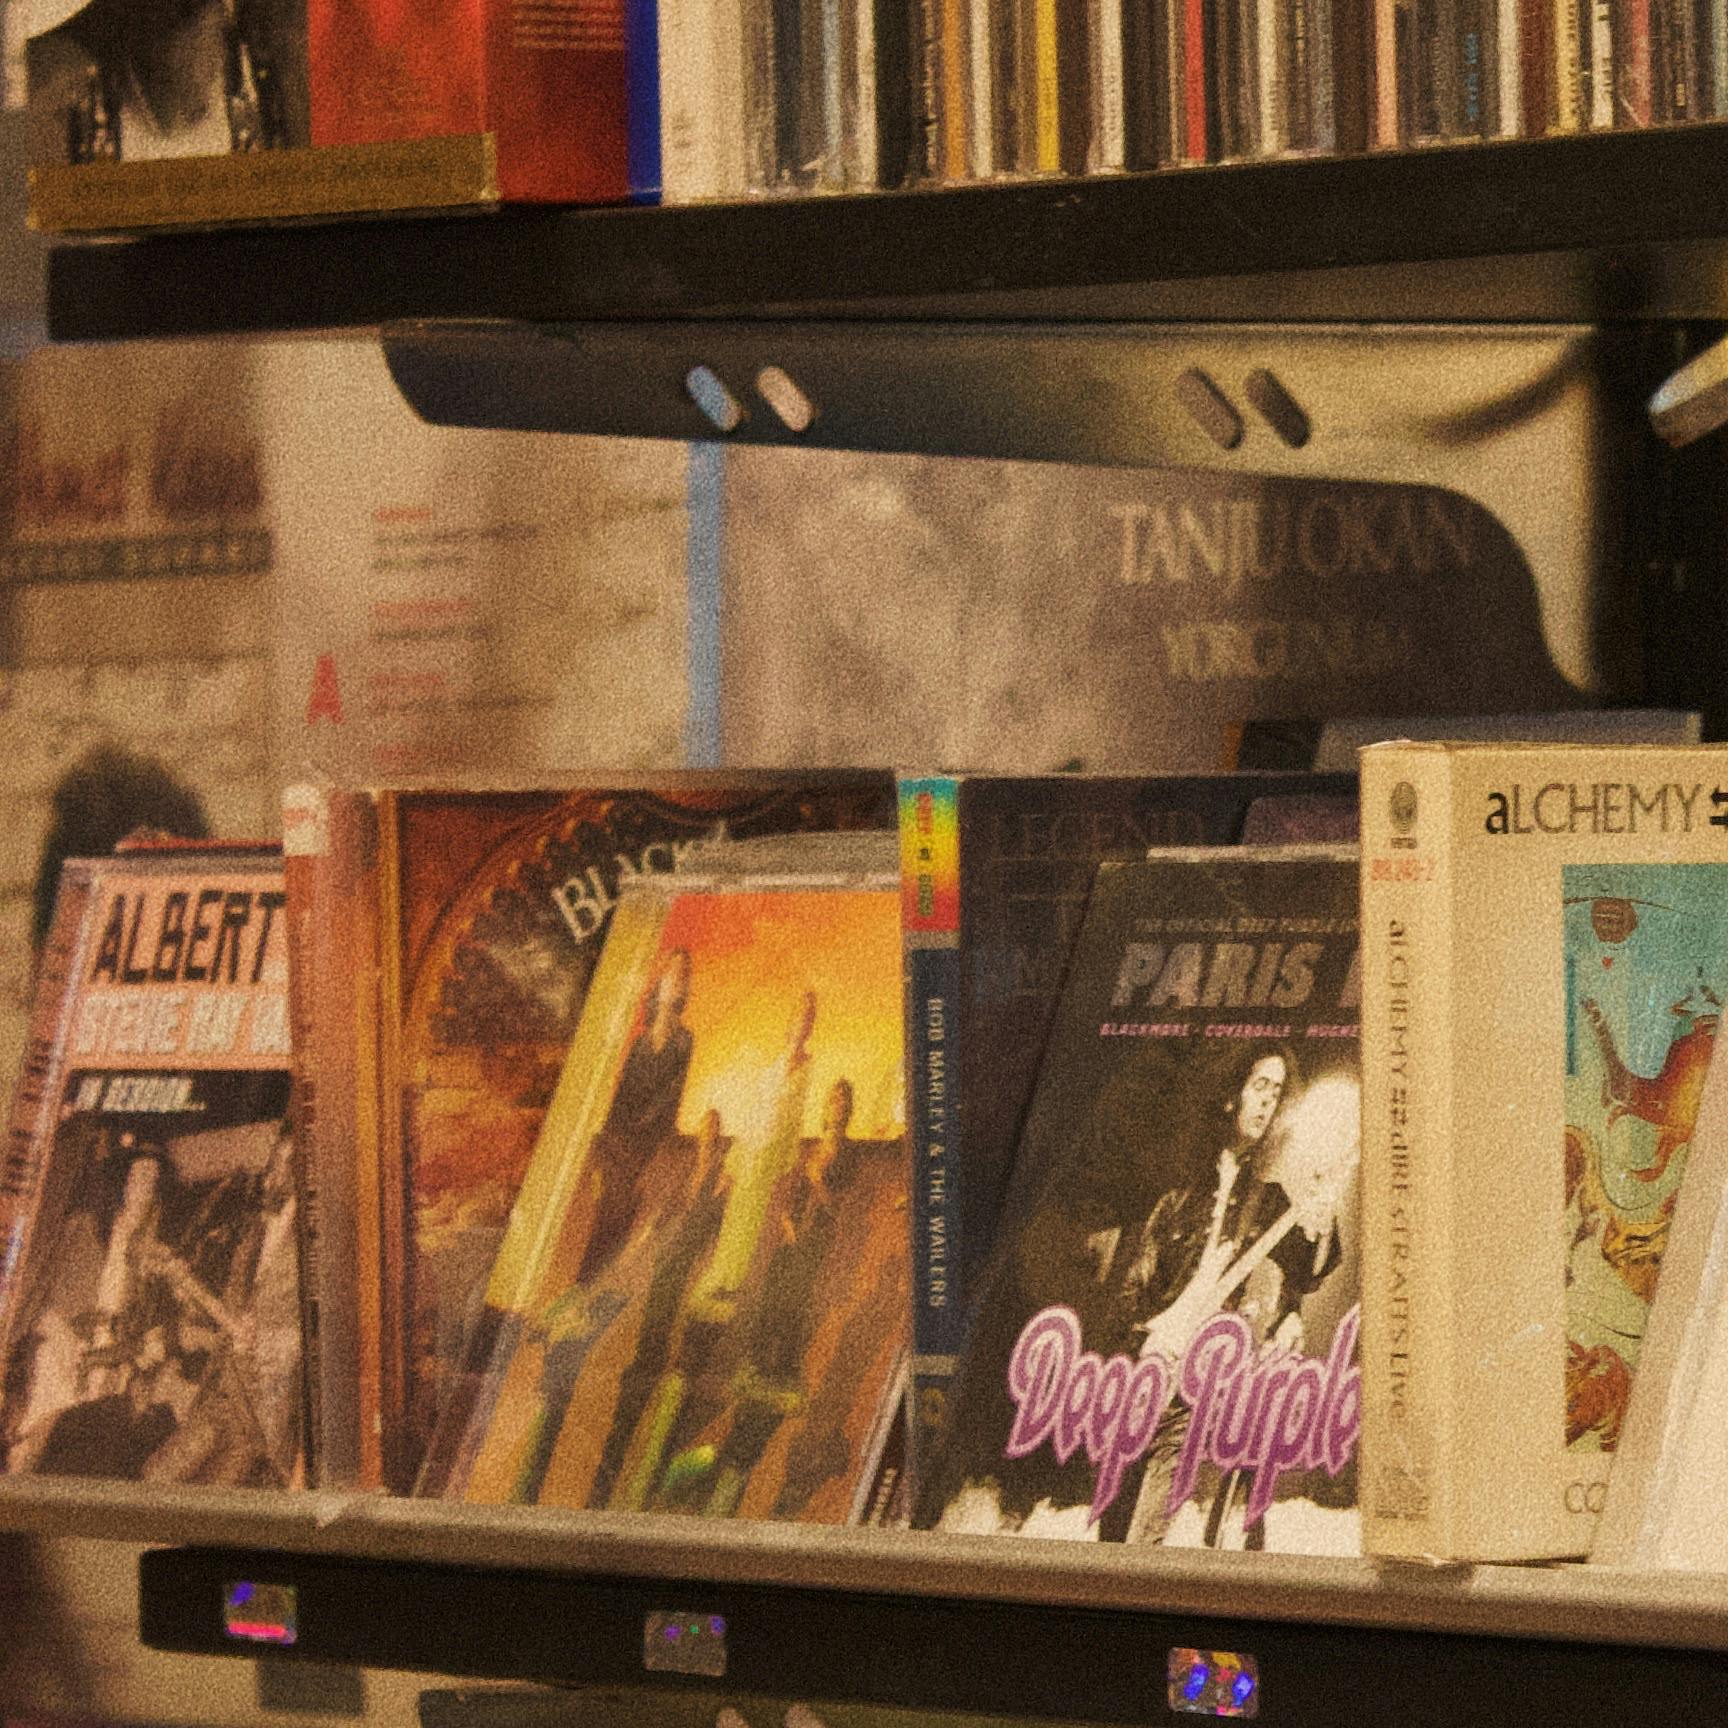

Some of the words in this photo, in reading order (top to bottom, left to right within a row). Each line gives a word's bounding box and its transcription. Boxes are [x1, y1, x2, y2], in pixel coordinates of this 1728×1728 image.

[91, 888, 288, 985] ALBERT
[1109, 940, 1326, 1009] PARIS
[927, 997, 943, 1040] BOB
[1305, 1022, 1360, 1039] HUGHE
[927, 1049, 943, 1136] MARLEY
[927, 1142, 943, 1157] &
[927, 1166, 943, 1204] THE
[927, 1215, 943, 1309] WAILERS
[1006, 1304, 1174, 1526] Deep
[1164, 1312, 1361, 1532] Purple
